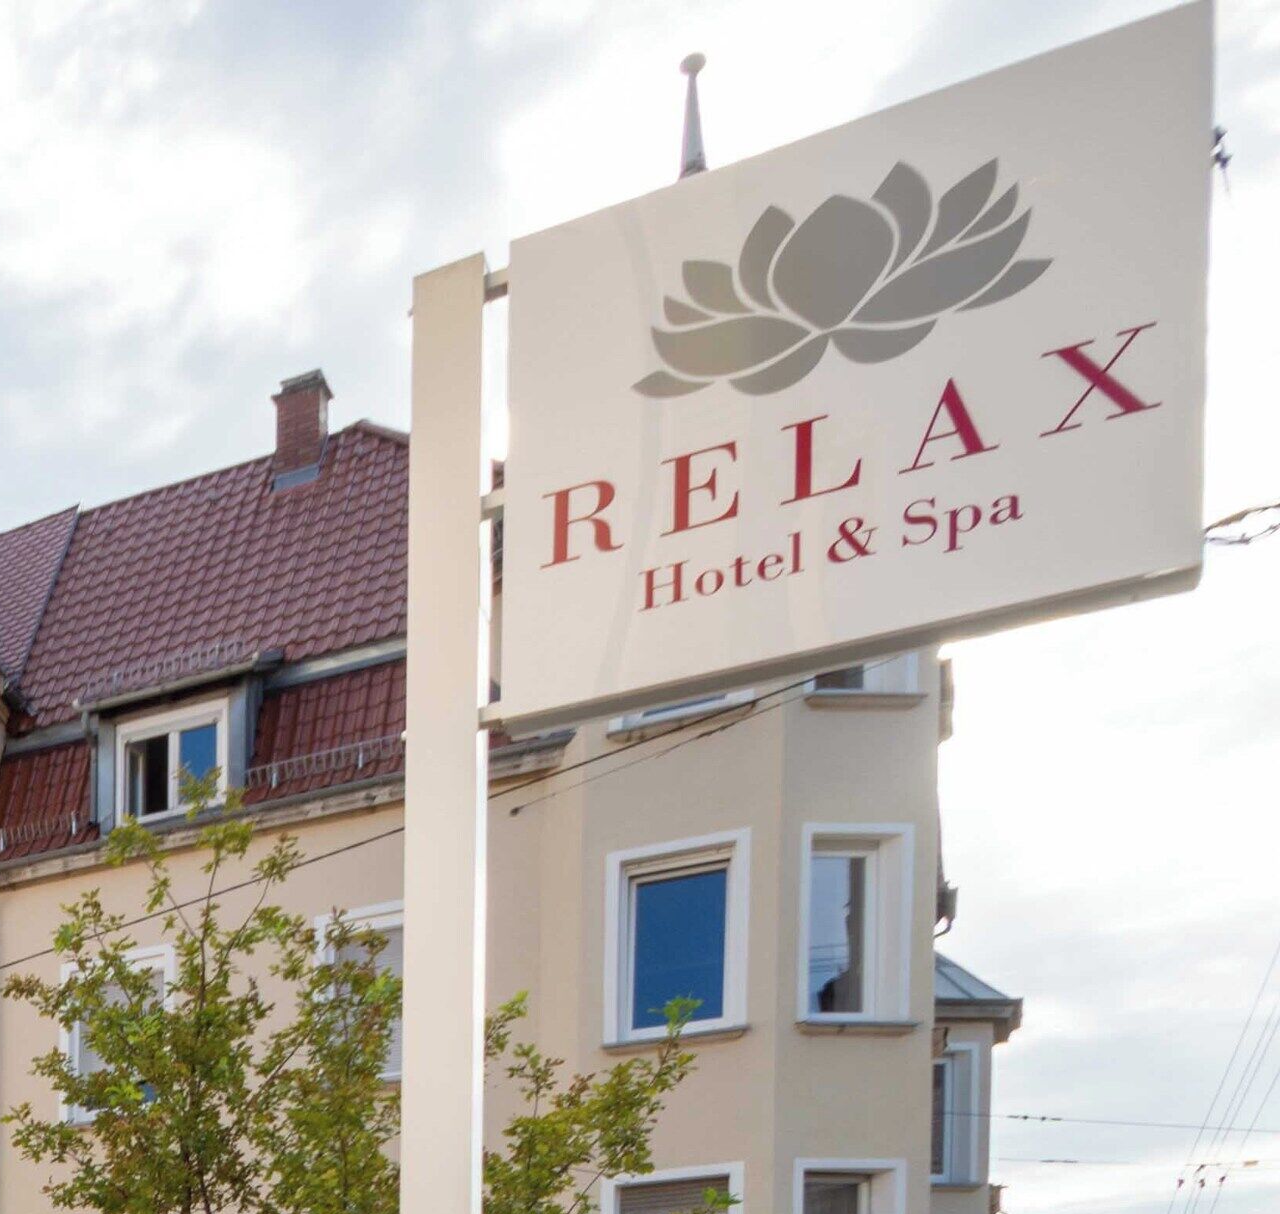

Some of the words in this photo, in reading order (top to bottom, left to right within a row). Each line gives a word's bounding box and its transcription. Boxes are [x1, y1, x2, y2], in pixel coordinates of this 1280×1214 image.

[540, 321, 1163, 569] RELAX
[638, 532, 803, 612] Hotel
[826, 516, 877, 564] &
[900, 494, 1024, 553] Spa
